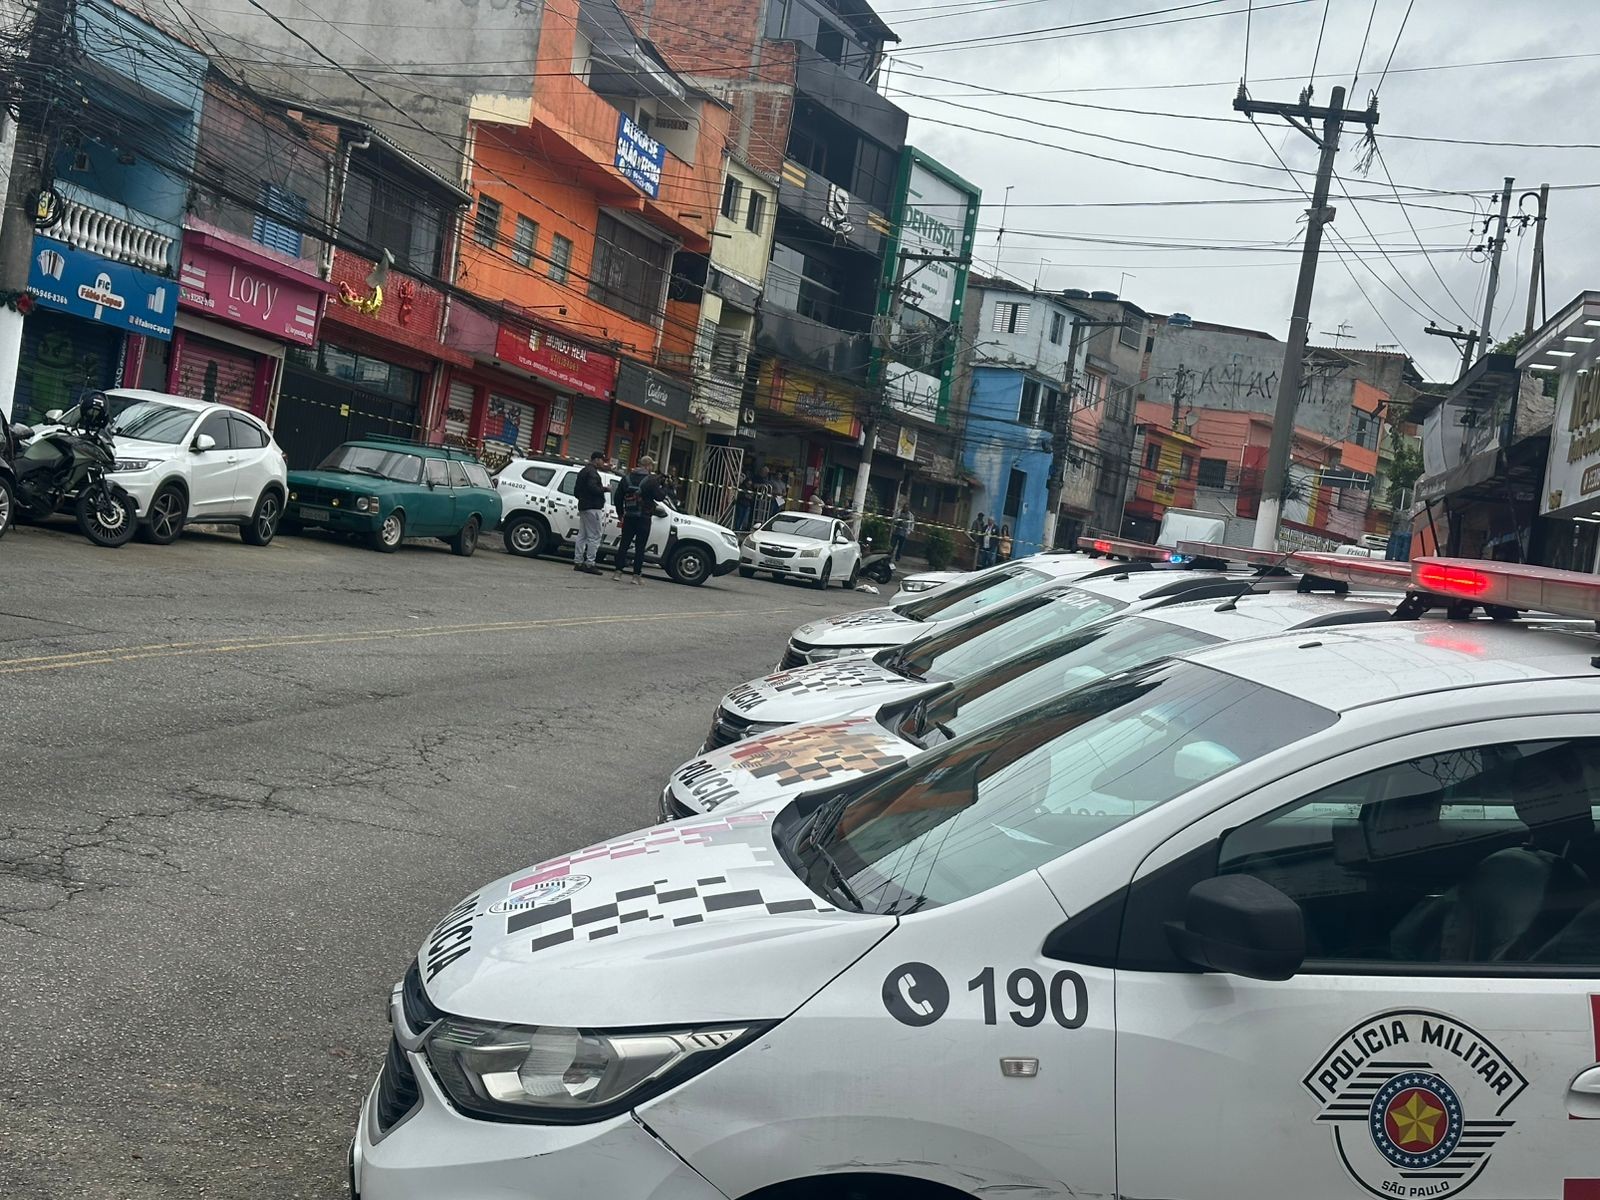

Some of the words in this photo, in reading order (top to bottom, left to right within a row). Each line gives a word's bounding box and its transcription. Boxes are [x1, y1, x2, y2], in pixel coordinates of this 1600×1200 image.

[903, 205, 955, 251] DENTISTA
[229, 266, 278, 320] Lory
[674, 760, 739, 812] POLÍCIA
[426, 894, 483, 984] POLÍCIA
[967, 967, 1088, 1029] 190
[1318, 1020, 1409, 1094] POLÍCIA
[1421, 1020, 1513, 1096] MILITAR
[1381, 1180, 1405, 1196] SÃO
[1409, 1180, 1450, 1197] PAULO
